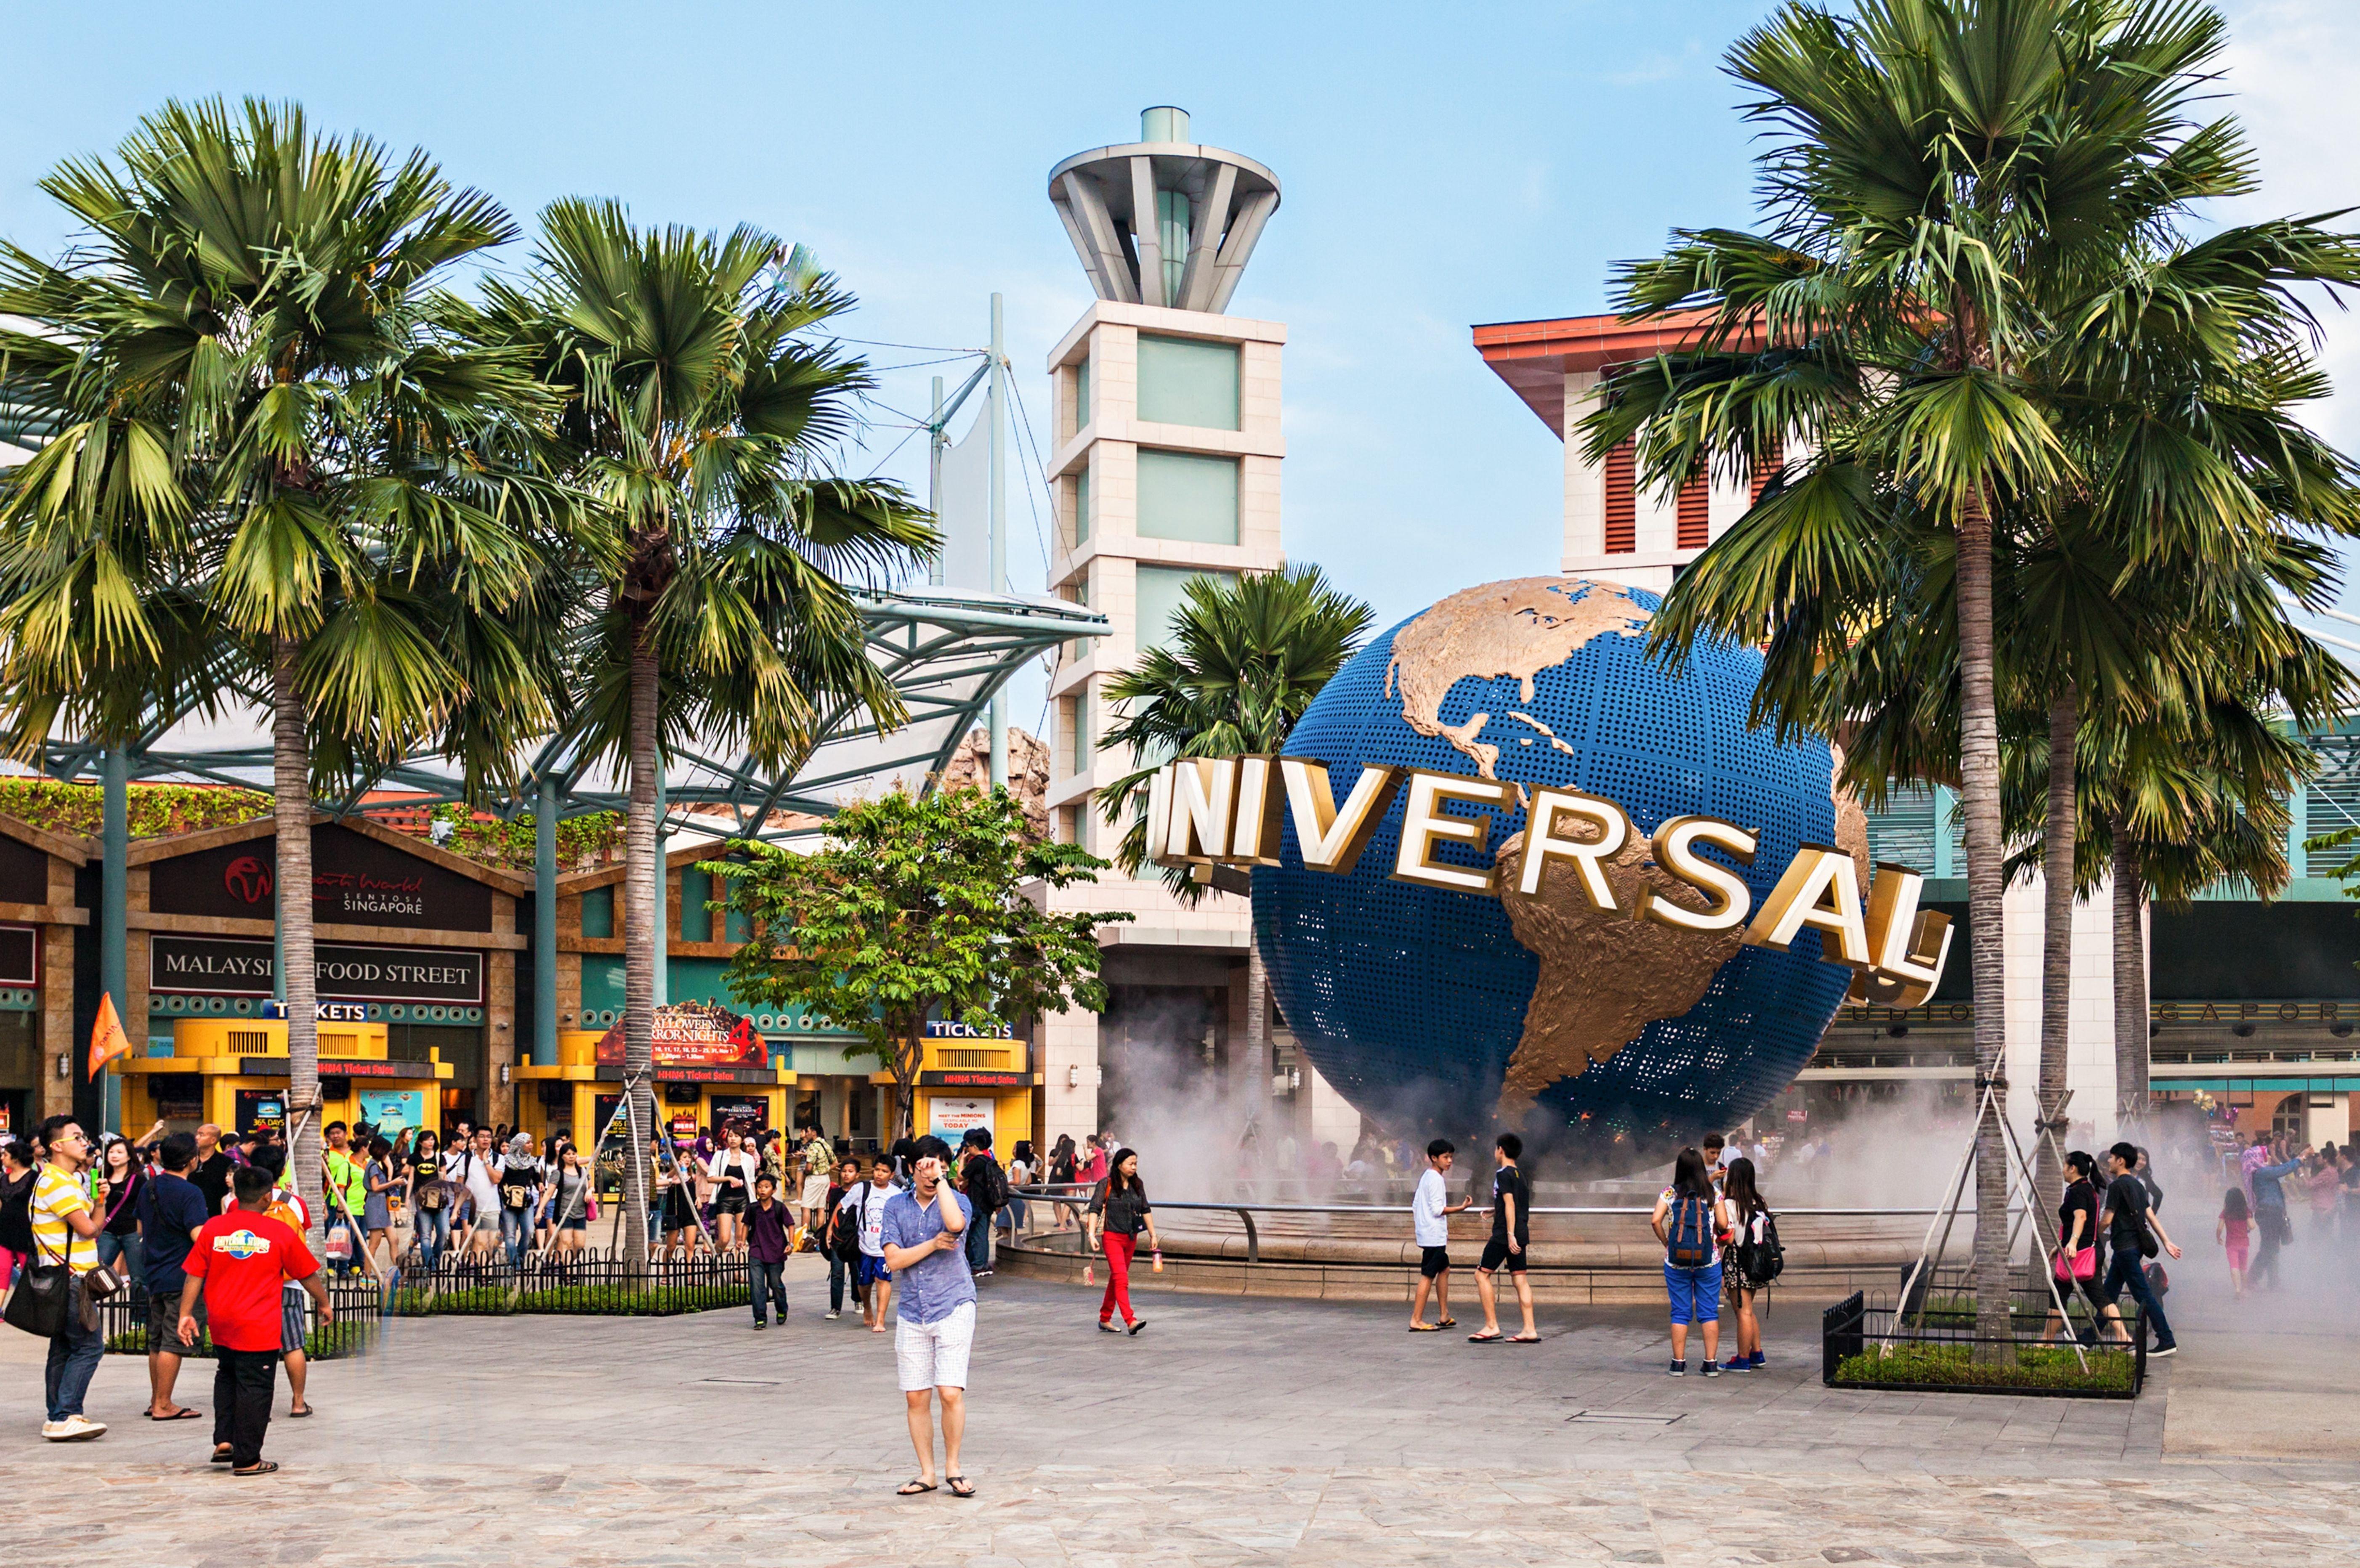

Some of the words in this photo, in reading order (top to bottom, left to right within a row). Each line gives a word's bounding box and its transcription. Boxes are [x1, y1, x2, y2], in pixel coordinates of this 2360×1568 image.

[1146, 753, 1940, 987] UNIVERSAL
[344, 892, 421, 903] SENTOSA
[344, 900, 422, 915] SINGAPORE
[166, 954, 273, 976] MALAYSI
[316, 962, 380, 981] FOOD
[386, 965, 470, 984] STREET
[274, 1002, 365, 1020] TKETS
[1852, 1004, 1970, 1021] UDIO
[2158, 1002, 2339, 1021] GAPOR
[652, 1017, 716, 1030] ALLOWEEN
[932, 1023, 1012, 1037] TICKTS
[651, 1029, 682, 1040] RROR
[682, 1029, 729, 1043] NIGHTS
[728, 1017, 751, 1055] 4
[343, 1063, 370, 1074] Ticket
[372, 1064, 394, 1075] Sales
[657, 1070, 684, 1079] HHN4
[686, 1070, 712, 1080] Ticket
[713, 1071, 734, 1080] Sales
[944, 1075, 970, 1084] HHN4
[971, 1075, 996, 1084] Ticket
[997, 1075, 1017, 1084] Sales
